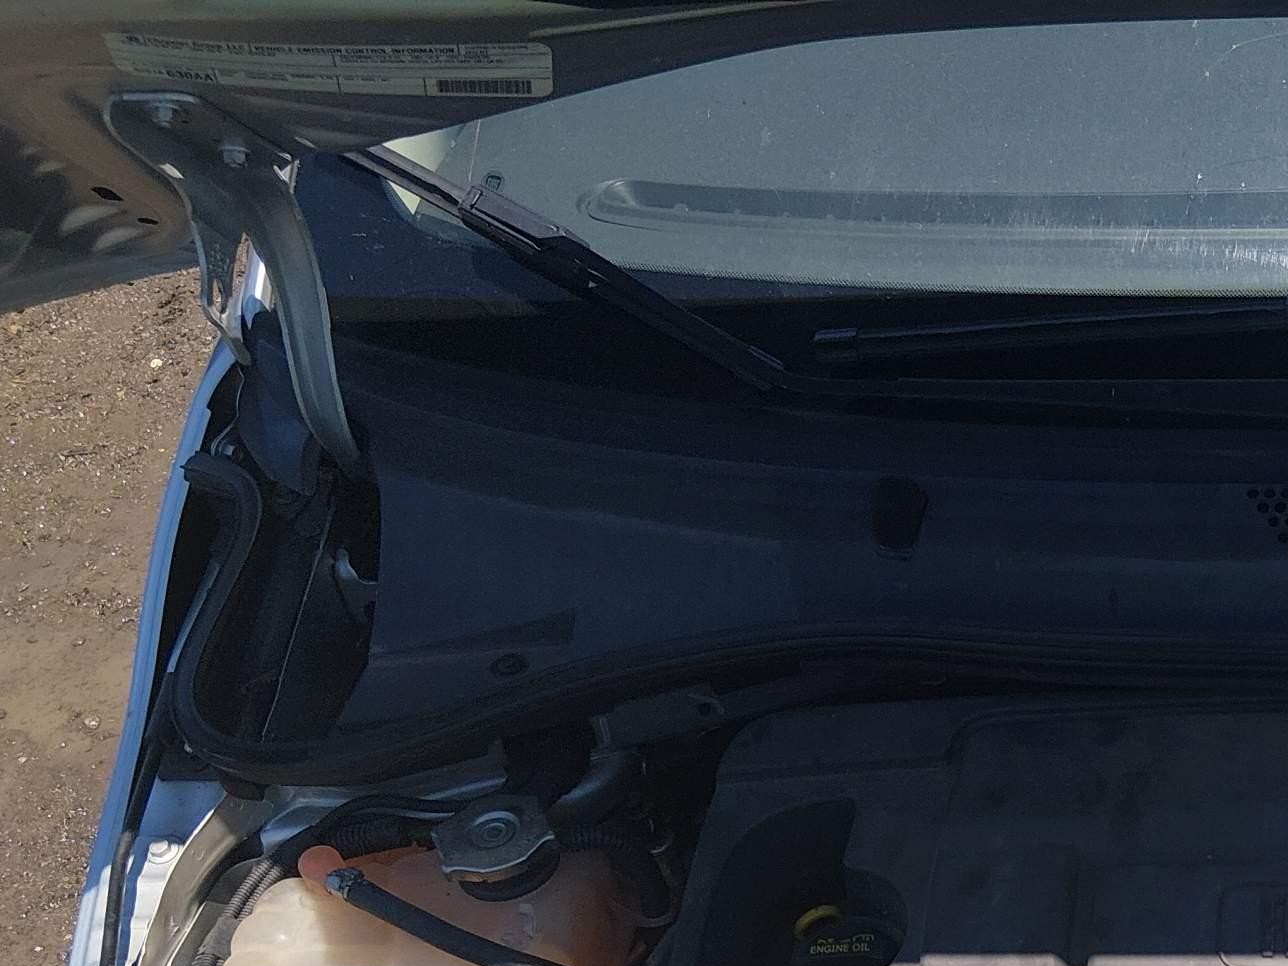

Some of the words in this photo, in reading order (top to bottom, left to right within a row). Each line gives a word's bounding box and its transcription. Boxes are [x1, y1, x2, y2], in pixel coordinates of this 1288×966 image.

[297, 47, 342, 55] EMISSION
[345, 47, 386, 55] CONTROL
[391, 47, 455, 55] INFORMATION
[809, 944, 850, 955] ENGINE
[852, 943, 871, 952] OIL
